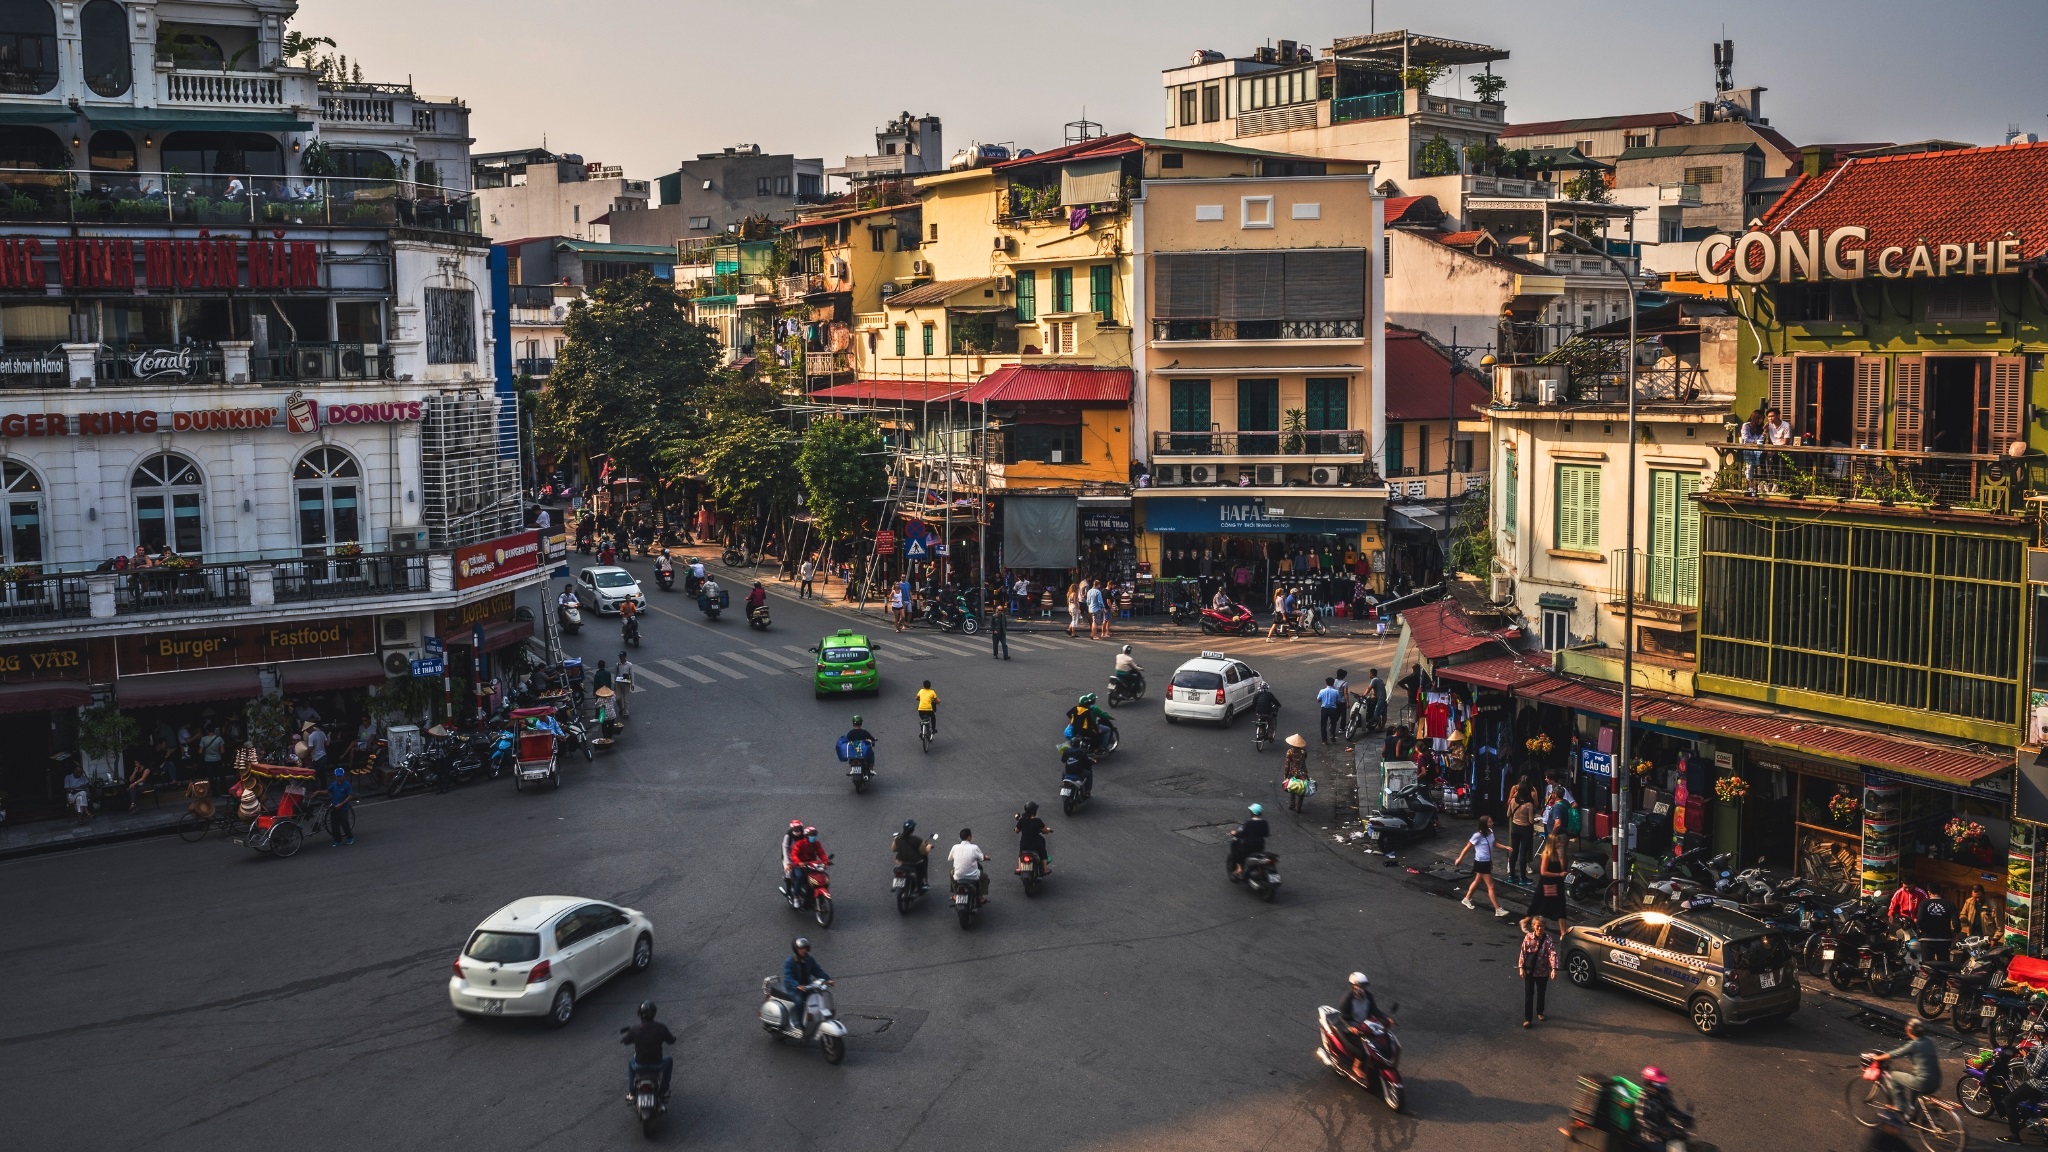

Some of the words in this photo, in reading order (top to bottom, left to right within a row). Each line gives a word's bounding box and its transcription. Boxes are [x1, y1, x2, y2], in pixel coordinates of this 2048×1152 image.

[56, 239, 136, 288] VINH
[145, 228, 239, 288] MUÔN
[248, 229, 318, 288] NĂM
[0, 358, 12, 373] ent
[13, 358, 32, 374] show
[33, 358, 40, 373] in
[41, 357, 63, 373] Hanoi
[1, 413, 68, 437] GER
[79, 410, 158, 435] KING
[173, 407, 278, 431] DUNKIN'
[328, 402, 422, 425] DONUTS
[505, 546, 525, 559] BURGER
[462, 601, 489, 624] LONG
[160, 636, 220, 657] Burger
[270, 628, 340, 646] Fastfood
[30, 648, 79, 670] VÂN
